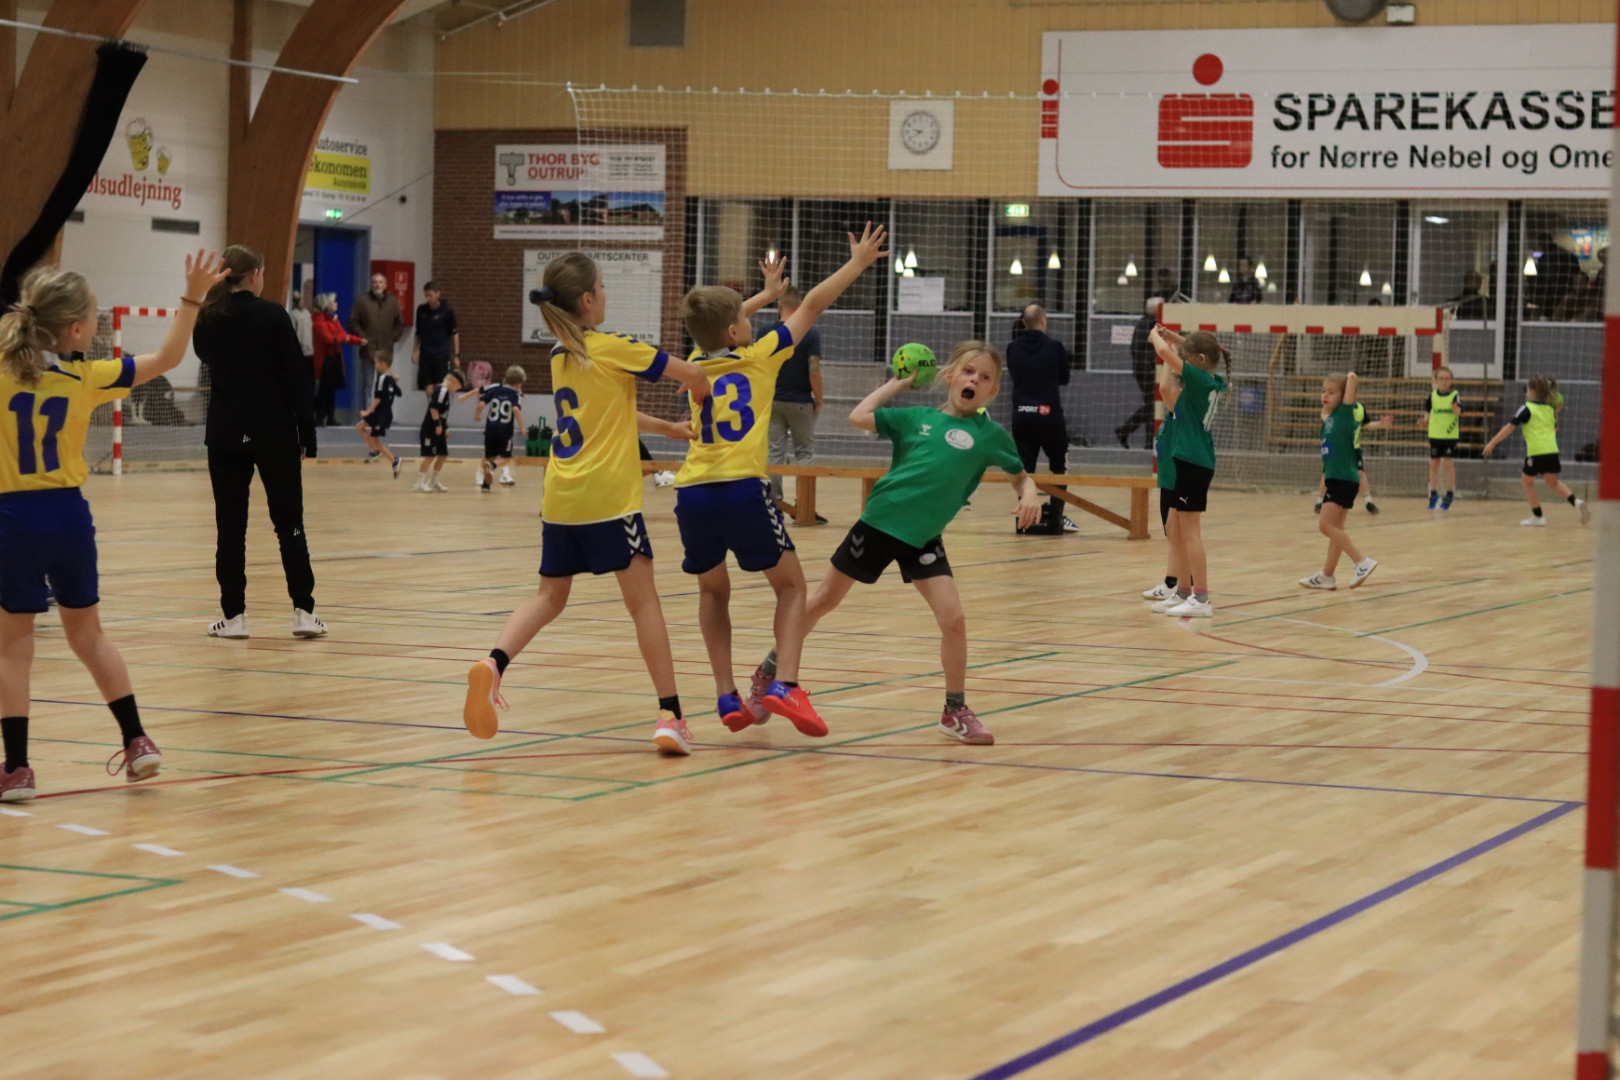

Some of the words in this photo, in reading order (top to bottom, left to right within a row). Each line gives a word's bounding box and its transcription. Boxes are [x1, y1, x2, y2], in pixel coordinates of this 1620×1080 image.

[528, 153, 567, 165] THOR
[1271, 145, 1310, 168] for
[1320, 145, 1398, 169] Nørre
[1410, 145, 1490, 169] Nebel
[1502, 149, 1538, 174] og
[8, 392, 69, 474] 11
[488, 398, 513, 424] 89
[552, 387, 584, 459] 6
[700, 372, 755, 444] 13
